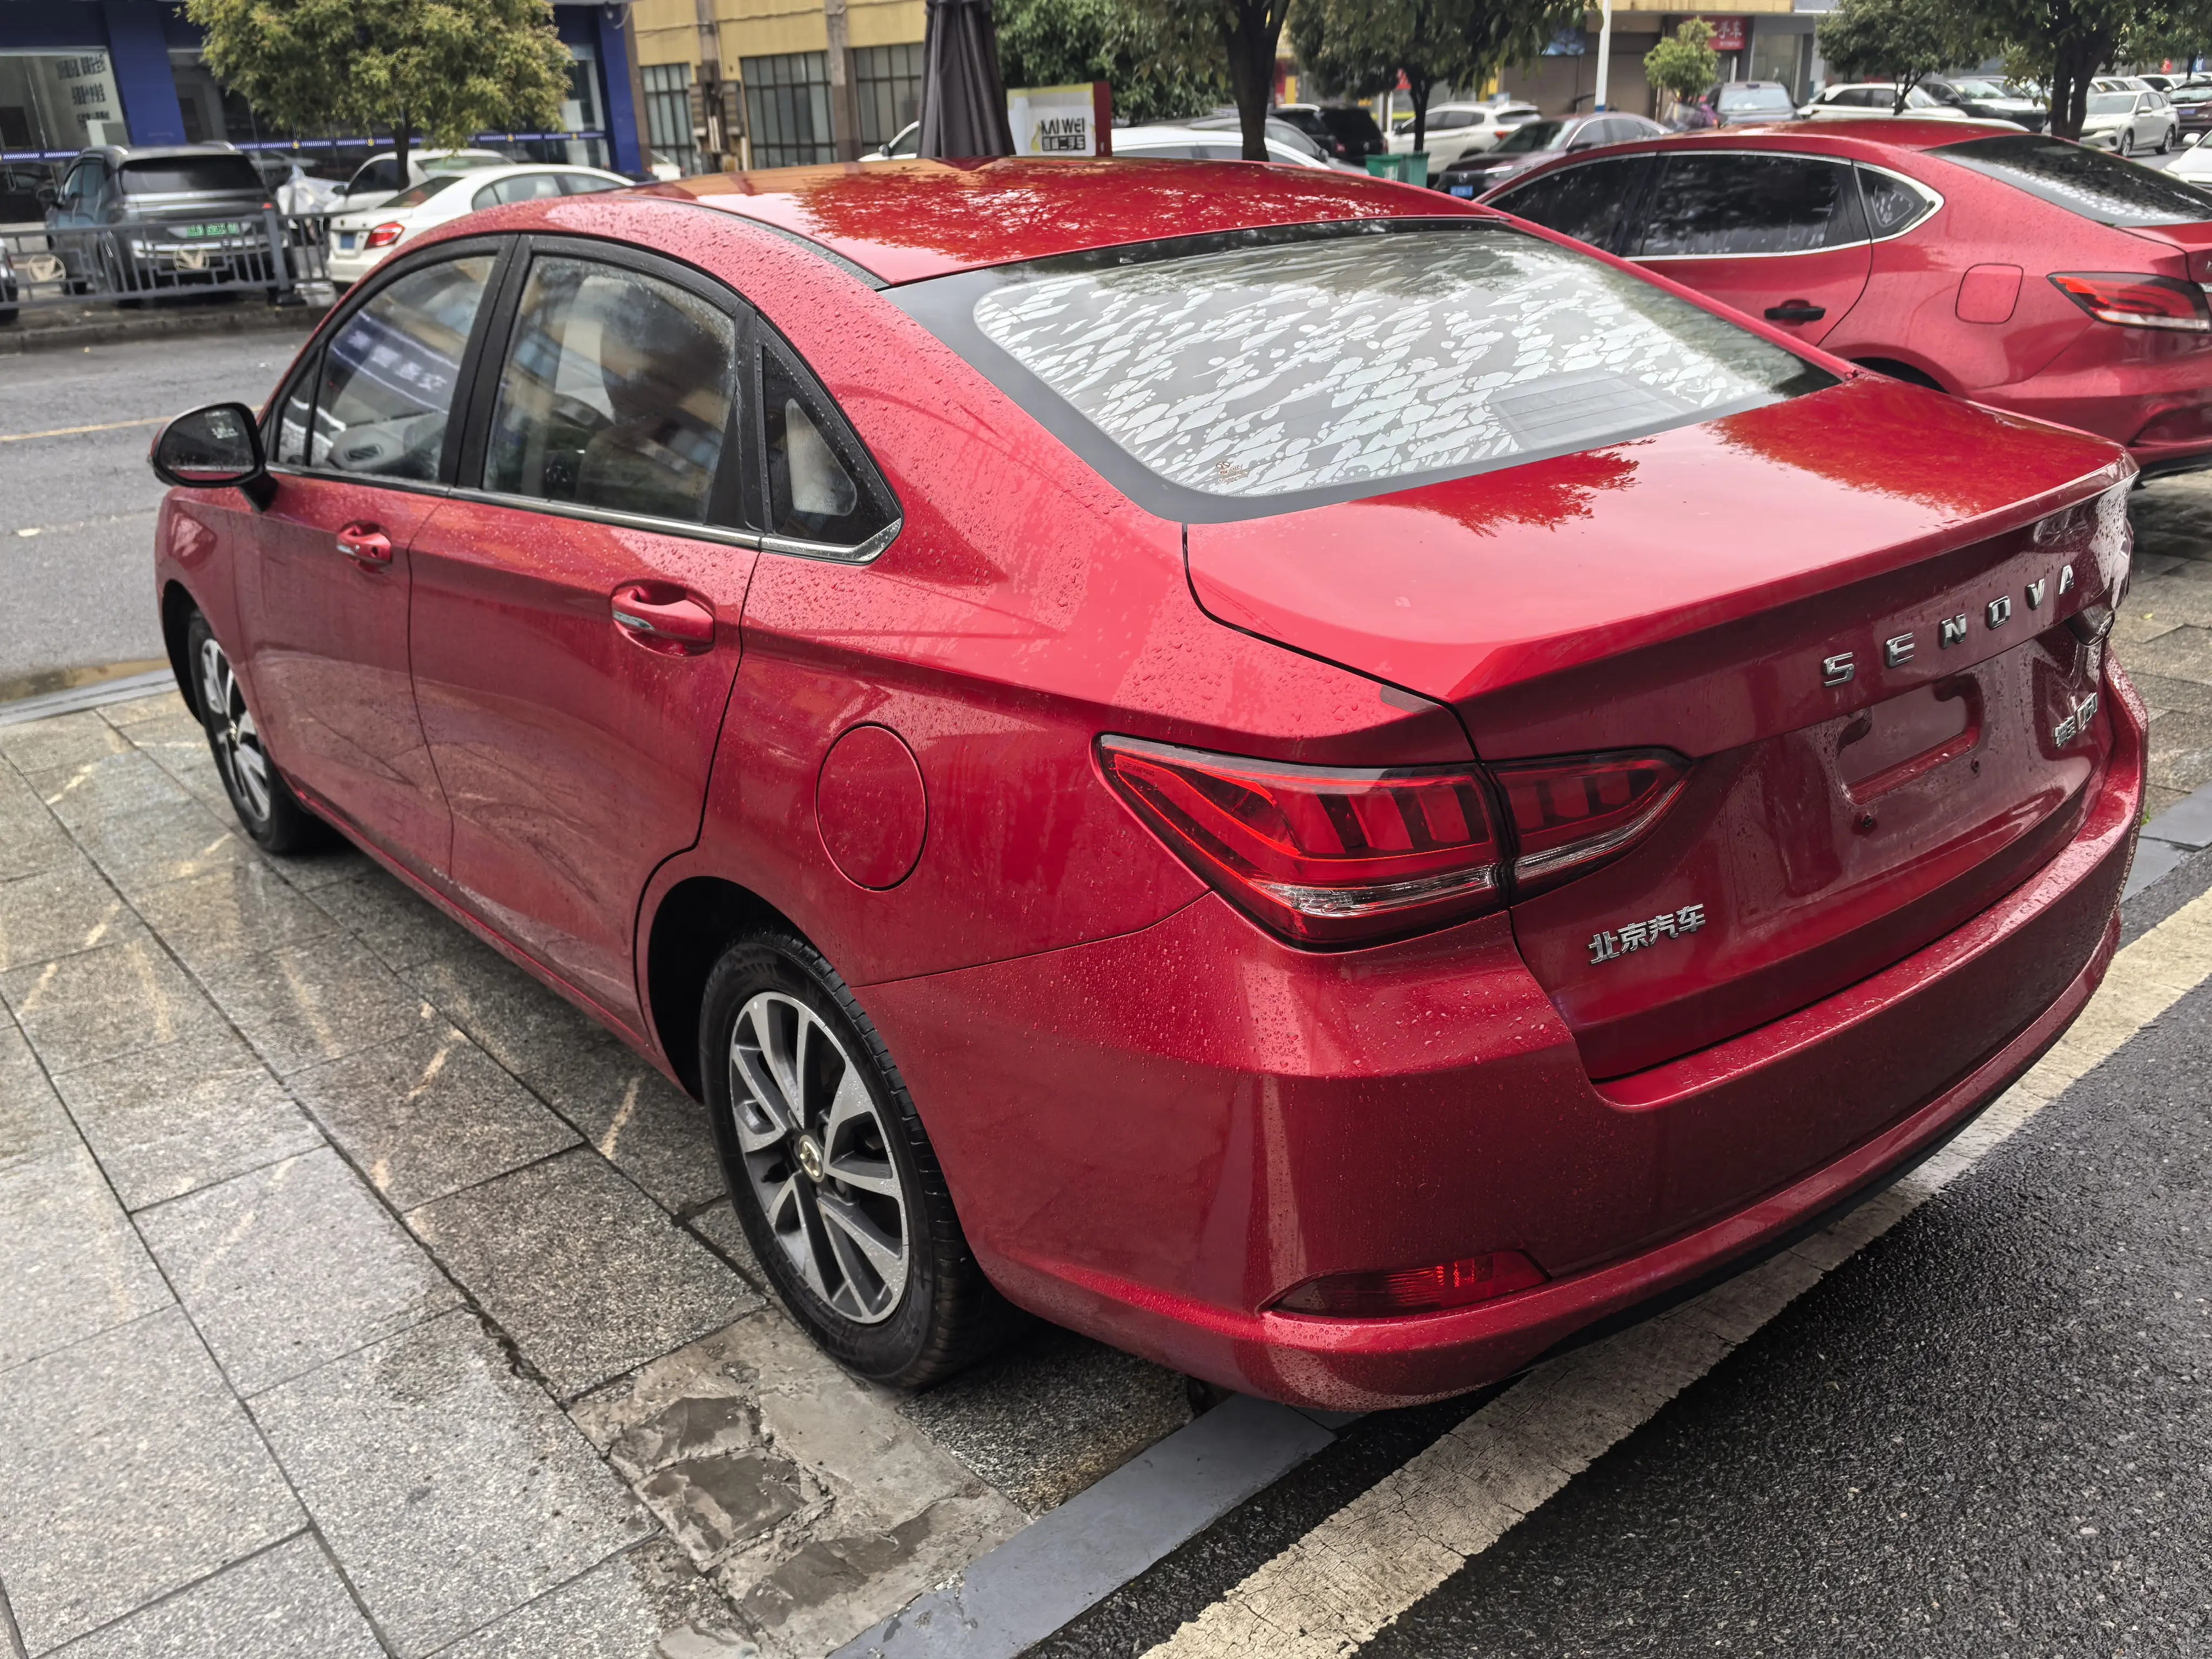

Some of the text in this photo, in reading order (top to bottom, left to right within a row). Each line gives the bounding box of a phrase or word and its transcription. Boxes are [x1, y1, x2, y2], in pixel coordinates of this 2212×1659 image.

[1823, 564, 2075, 687] SENOVA
[1588, 903, 1706, 965] 北京汽车
